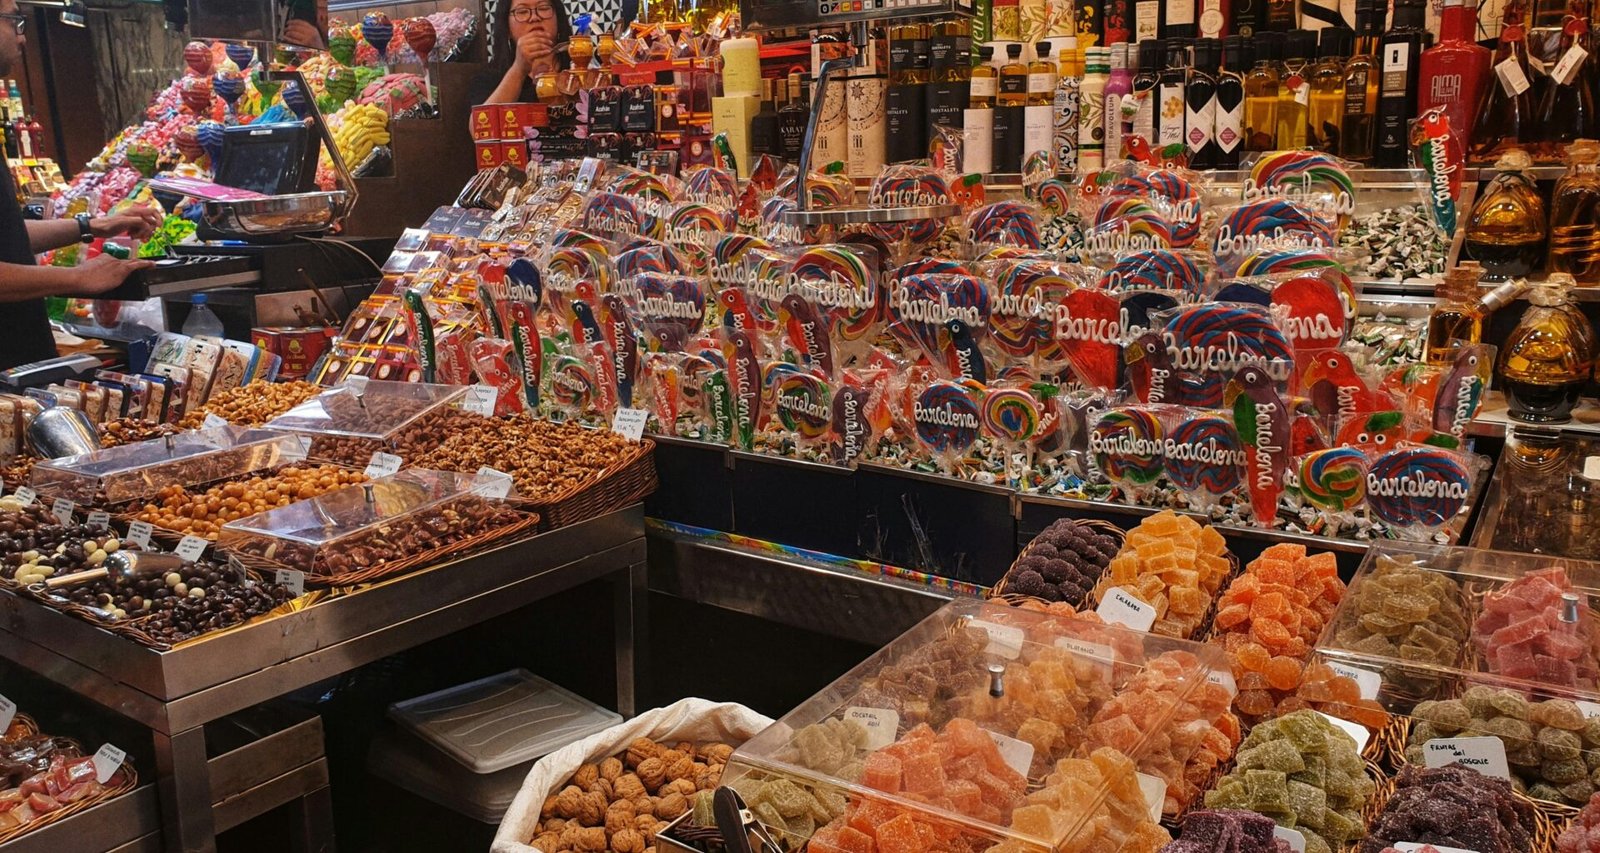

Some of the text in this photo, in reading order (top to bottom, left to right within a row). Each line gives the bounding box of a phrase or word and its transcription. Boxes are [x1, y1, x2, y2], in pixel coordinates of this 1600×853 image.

[1430, 134, 1457, 207] Barcelona
[871, 178, 948, 207] Barcelona
[588, 208, 639, 237] Barcelona
[1085, 220, 1164, 254] Barcelona
[1216, 225, 1324, 257] Barcelona
[709, 253, 750, 286] Barcel
[636, 287, 702, 319] Barcelona
[788, 270, 876, 309] Barcelona
[900, 287, 985, 327] Barcelona
[990, 287, 1055, 321] Barcelo
[414, 312, 429, 371] Barcelona
[801, 321, 827, 370] Barcelo
[1055, 305, 1152, 347] Barcelo
[519, 326, 537, 387] Barcelona
[614, 321, 629, 384] Barcelona
[1163, 331, 1292, 380] Barcelona
[736, 358, 756, 428] Barcelona
[777, 388, 833, 420] Barcelona
[1451, 375, 1478, 436] Barcelo
[711, 385, 729, 441] Barcelona
[844, 400, 864, 460] Barcelona
[914, 402, 978, 428] Barcelona
[1090, 428, 1164, 455] Barcelona
[1164, 437, 1248, 465] Barcelona
[1255, 402, 1282, 490] Barcelona
[1367, 470, 1468, 498] Barcelona
